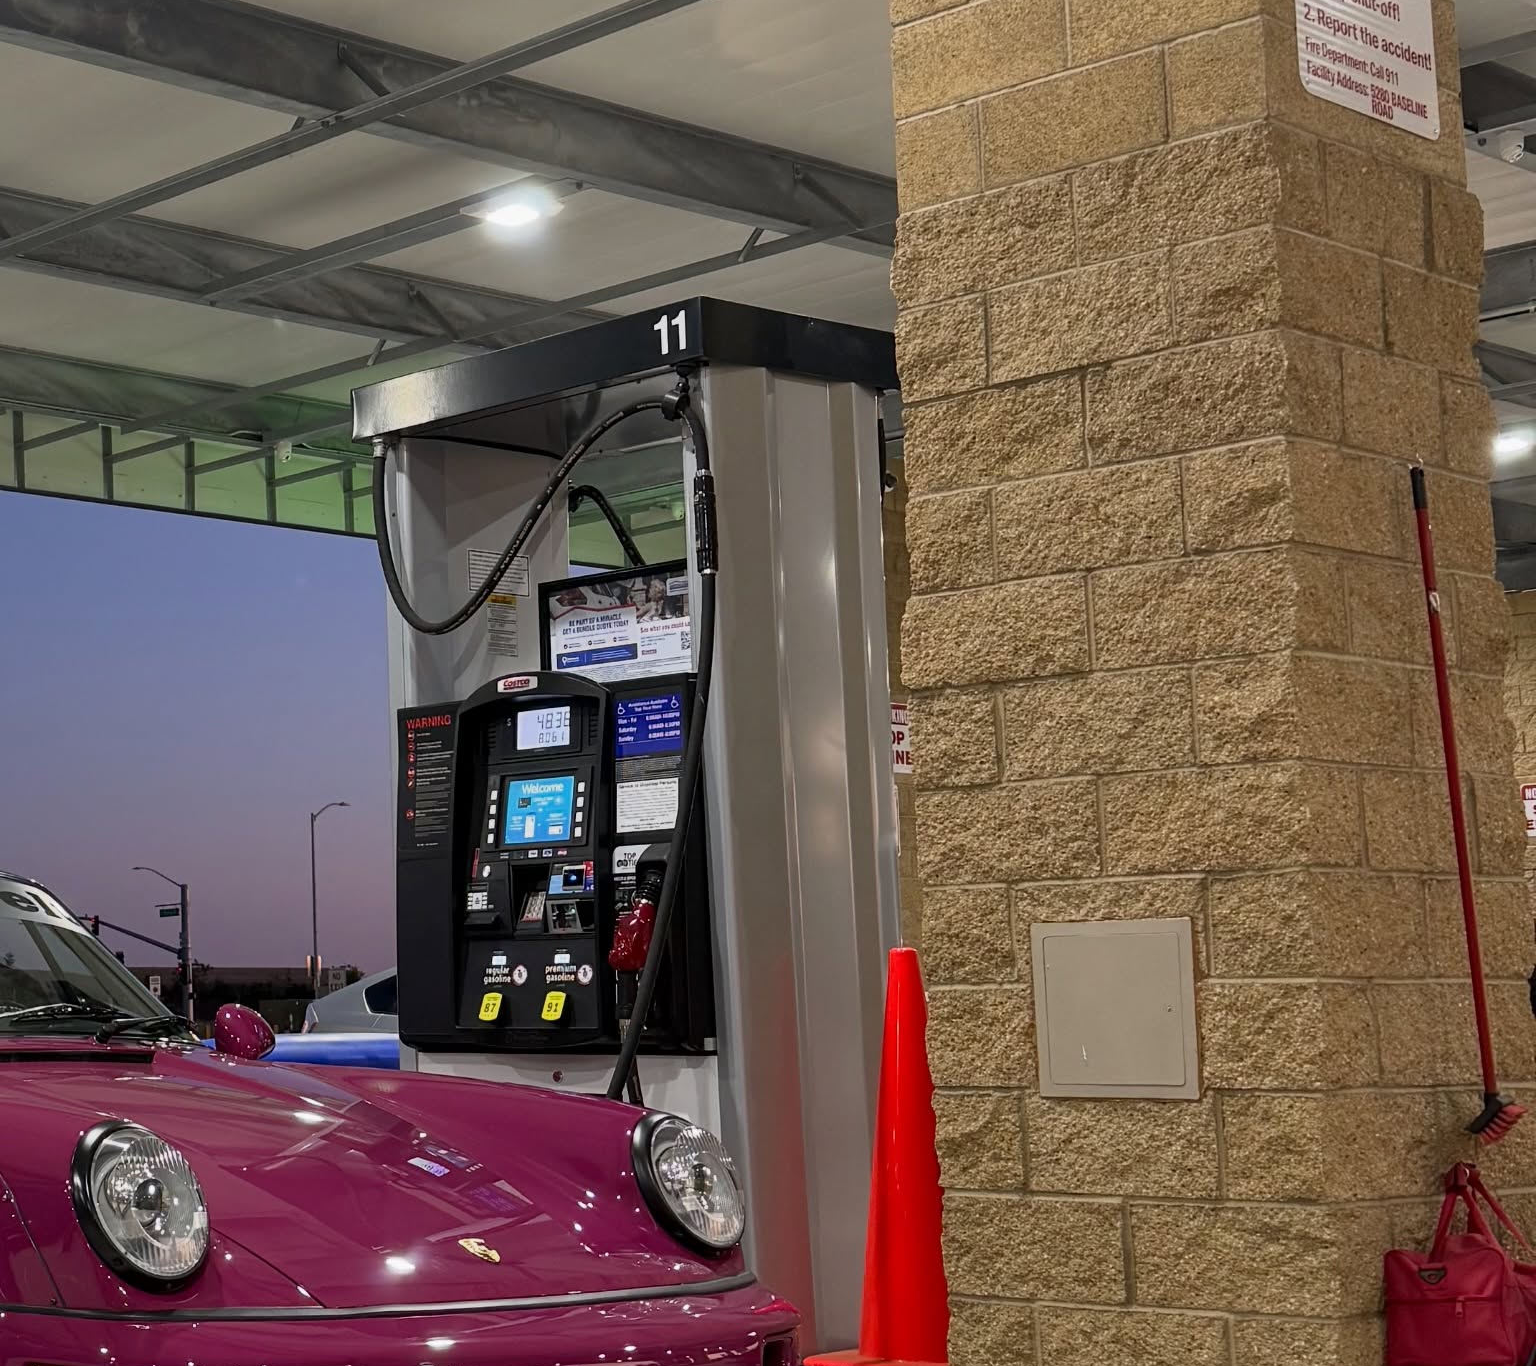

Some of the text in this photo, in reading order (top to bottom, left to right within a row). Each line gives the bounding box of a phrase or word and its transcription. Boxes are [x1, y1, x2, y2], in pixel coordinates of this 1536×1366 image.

[1304, 3, 1432, 71] 2. Report the accident!
[1305, 36, 1399, 86] Fire Department: Call 911
[1307, 60, 1335, 86] Facility
[1336, 71, 1369, 96] Address:
[1391, 92, 1429, 119] BASELINE
[1371, 100, 1394, 120] ROAD
[654, 309, 687, 355] 11
[503, 678, 530, 688] COSTCO
[406, 715, 452, 730] WARNING
[522, 782, 564, 795] Welcome
[485, 966, 510, 977] regular
[545, 965, 577, 975] premium
[483, 975, 512, 985] gasoline
[546, 973, 575, 984] gasoline
[484, 1002, 497, 1013] 87
[546, 1002, 559, 1012] 91
